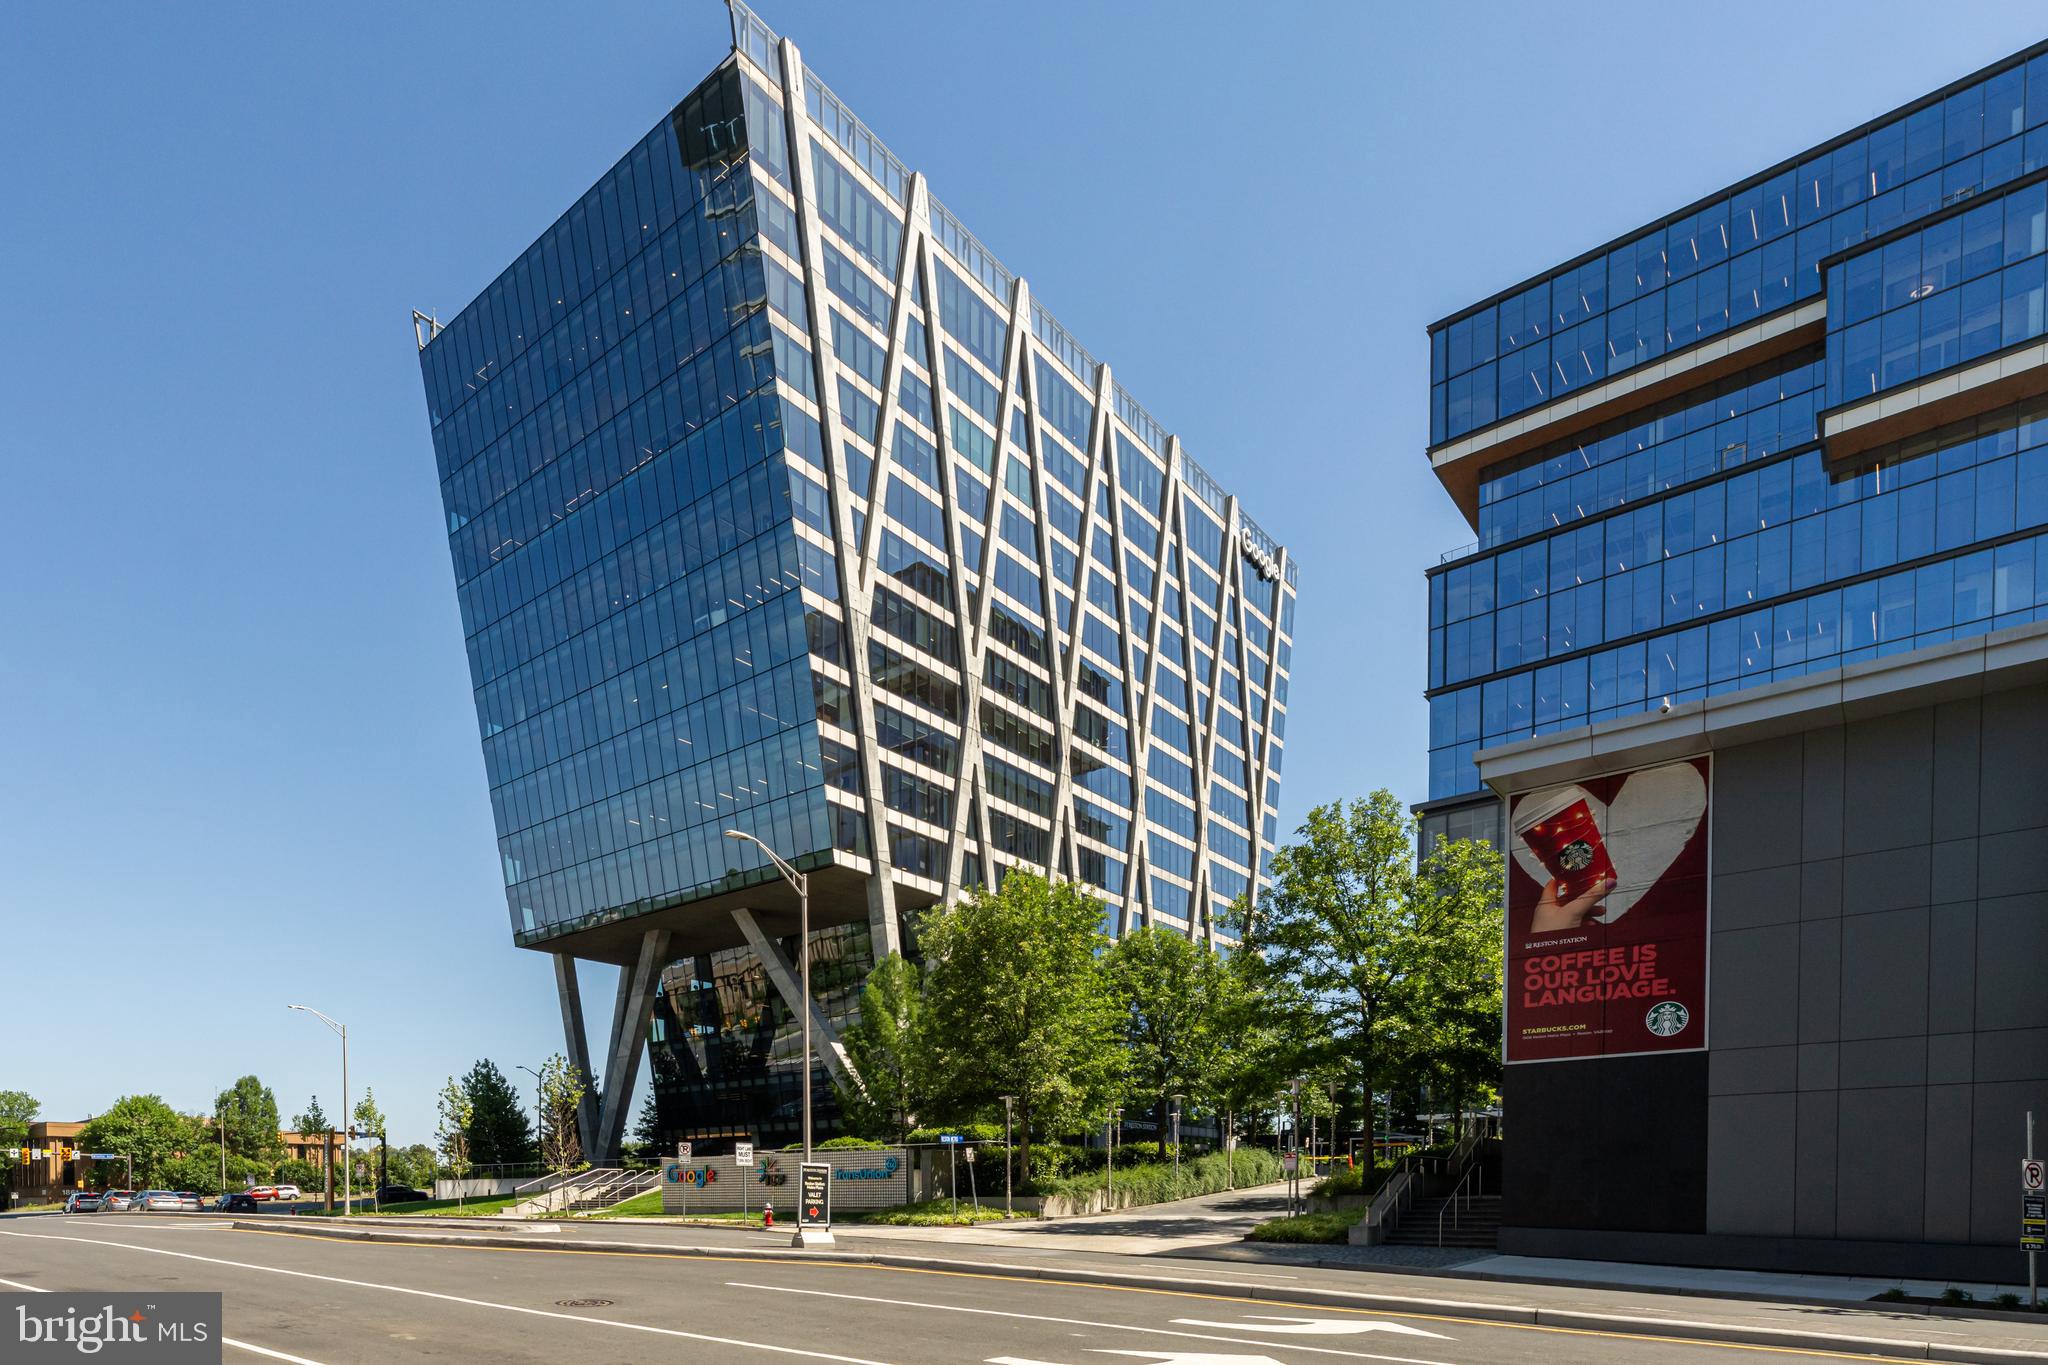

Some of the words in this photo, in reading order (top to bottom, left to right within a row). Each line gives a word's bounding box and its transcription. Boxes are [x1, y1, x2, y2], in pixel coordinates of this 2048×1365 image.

[1240, 527, 1280, 581] Google
[1533, 940, 1558, 948] RESTON
[1559, 936, 1588, 945] STATION
[1524, 947, 1625, 974] COFFEE
[1632, 944, 1657, 963] IS
[1524, 970, 1580, 991] OUR
[1586, 962, 1656, 985] LOVE
[1524, 978, 1677, 1008] LANGUAGE.
[1522, 1024, 1587, 1034] STARBUCKS.COM
[667, 1164, 715, 1188] Google
[835, 1168, 888, 1180] TransUnion
